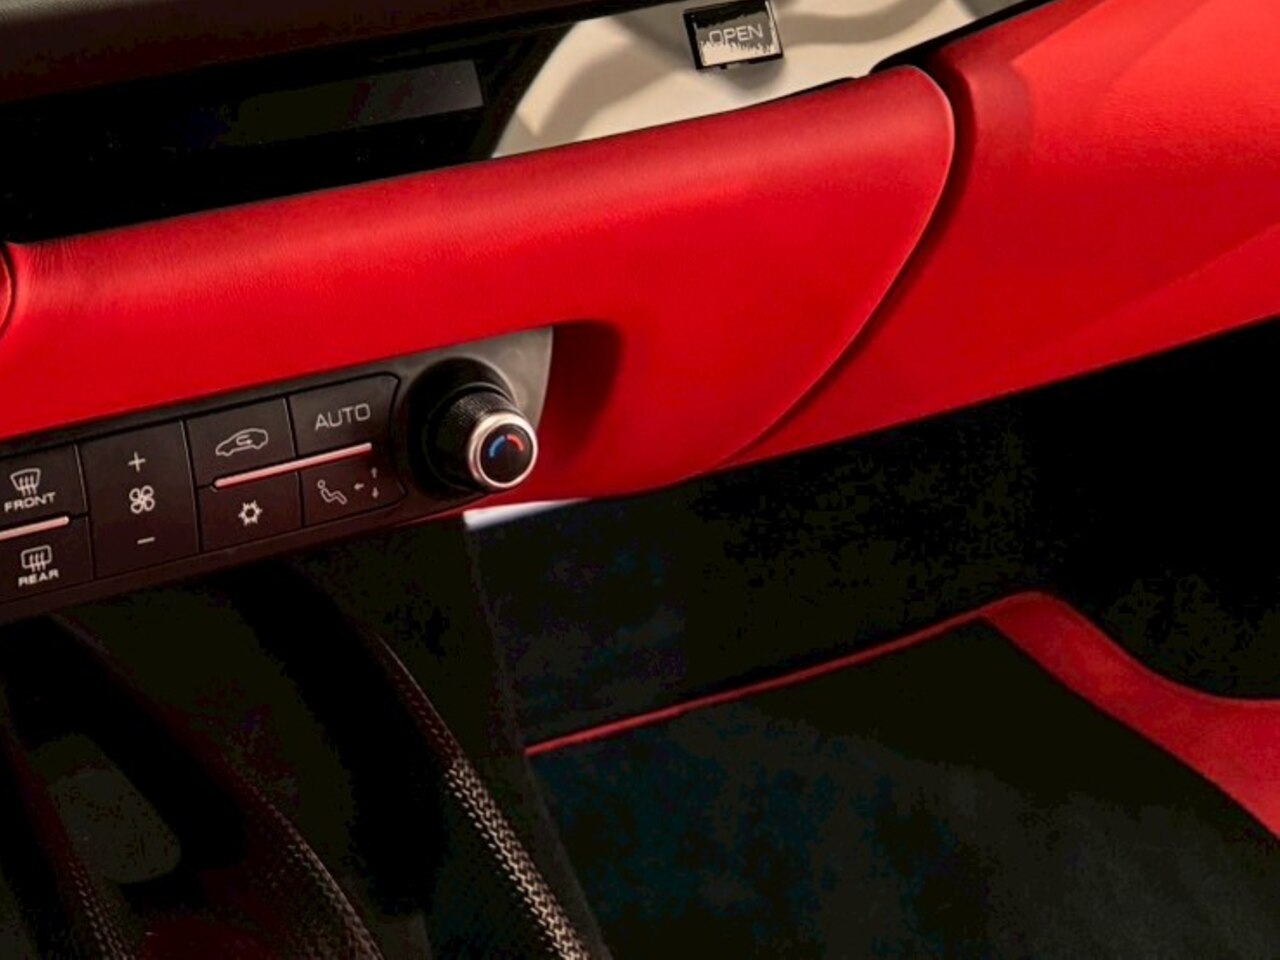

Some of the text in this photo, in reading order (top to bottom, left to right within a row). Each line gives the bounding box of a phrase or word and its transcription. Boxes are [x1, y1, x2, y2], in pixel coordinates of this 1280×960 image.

[709, 24, 763, 45] OPEN
[315, 403, 371, 431] AUTO
[4, 492, 56, 512] FRONT
[18, 569, 60, 587] REAR
